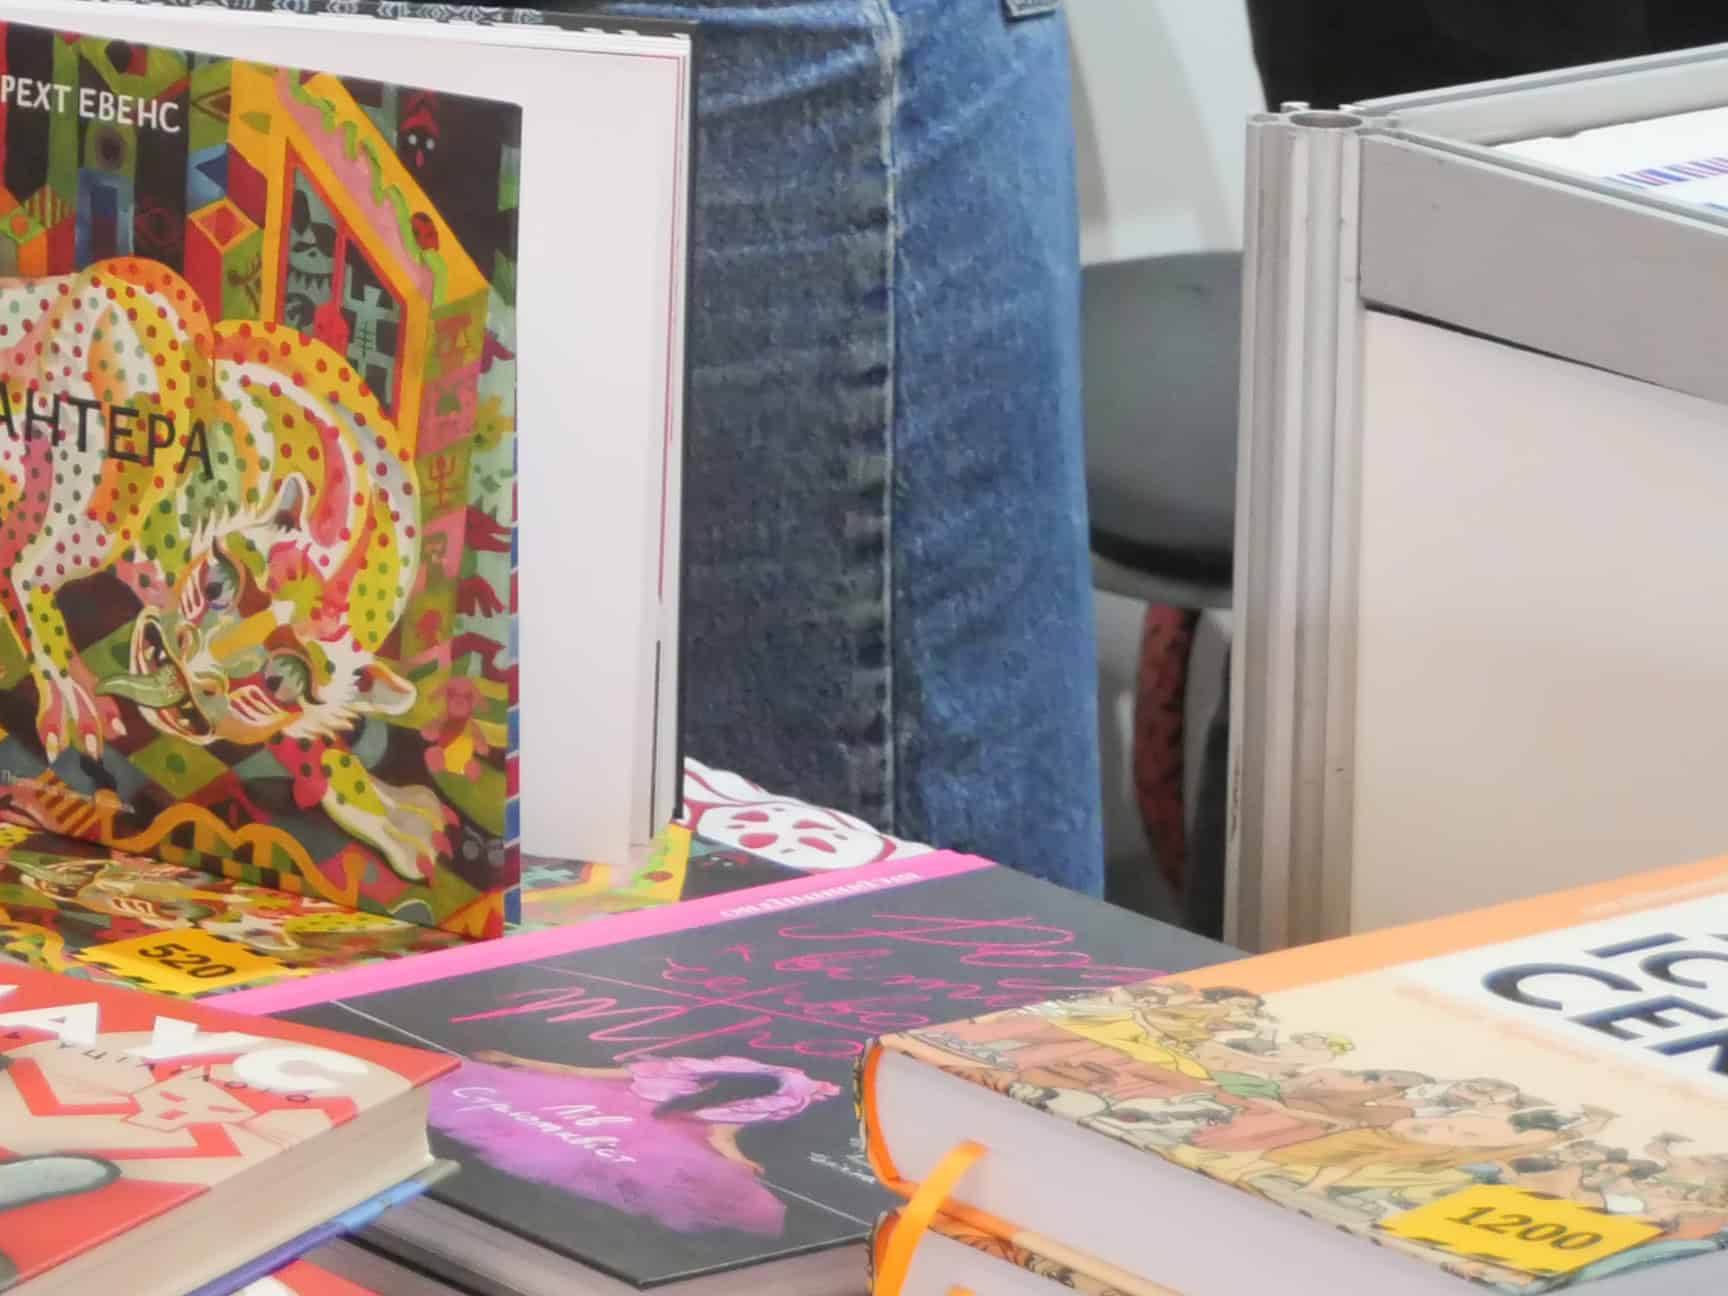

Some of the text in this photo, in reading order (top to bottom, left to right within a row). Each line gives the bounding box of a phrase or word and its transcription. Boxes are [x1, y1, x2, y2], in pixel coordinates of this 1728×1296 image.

[79, 88, 181, 134] ЕВЕНС
[138, 943, 236, 979] 520
[1444, 1206, 1603, 1250] 1200
